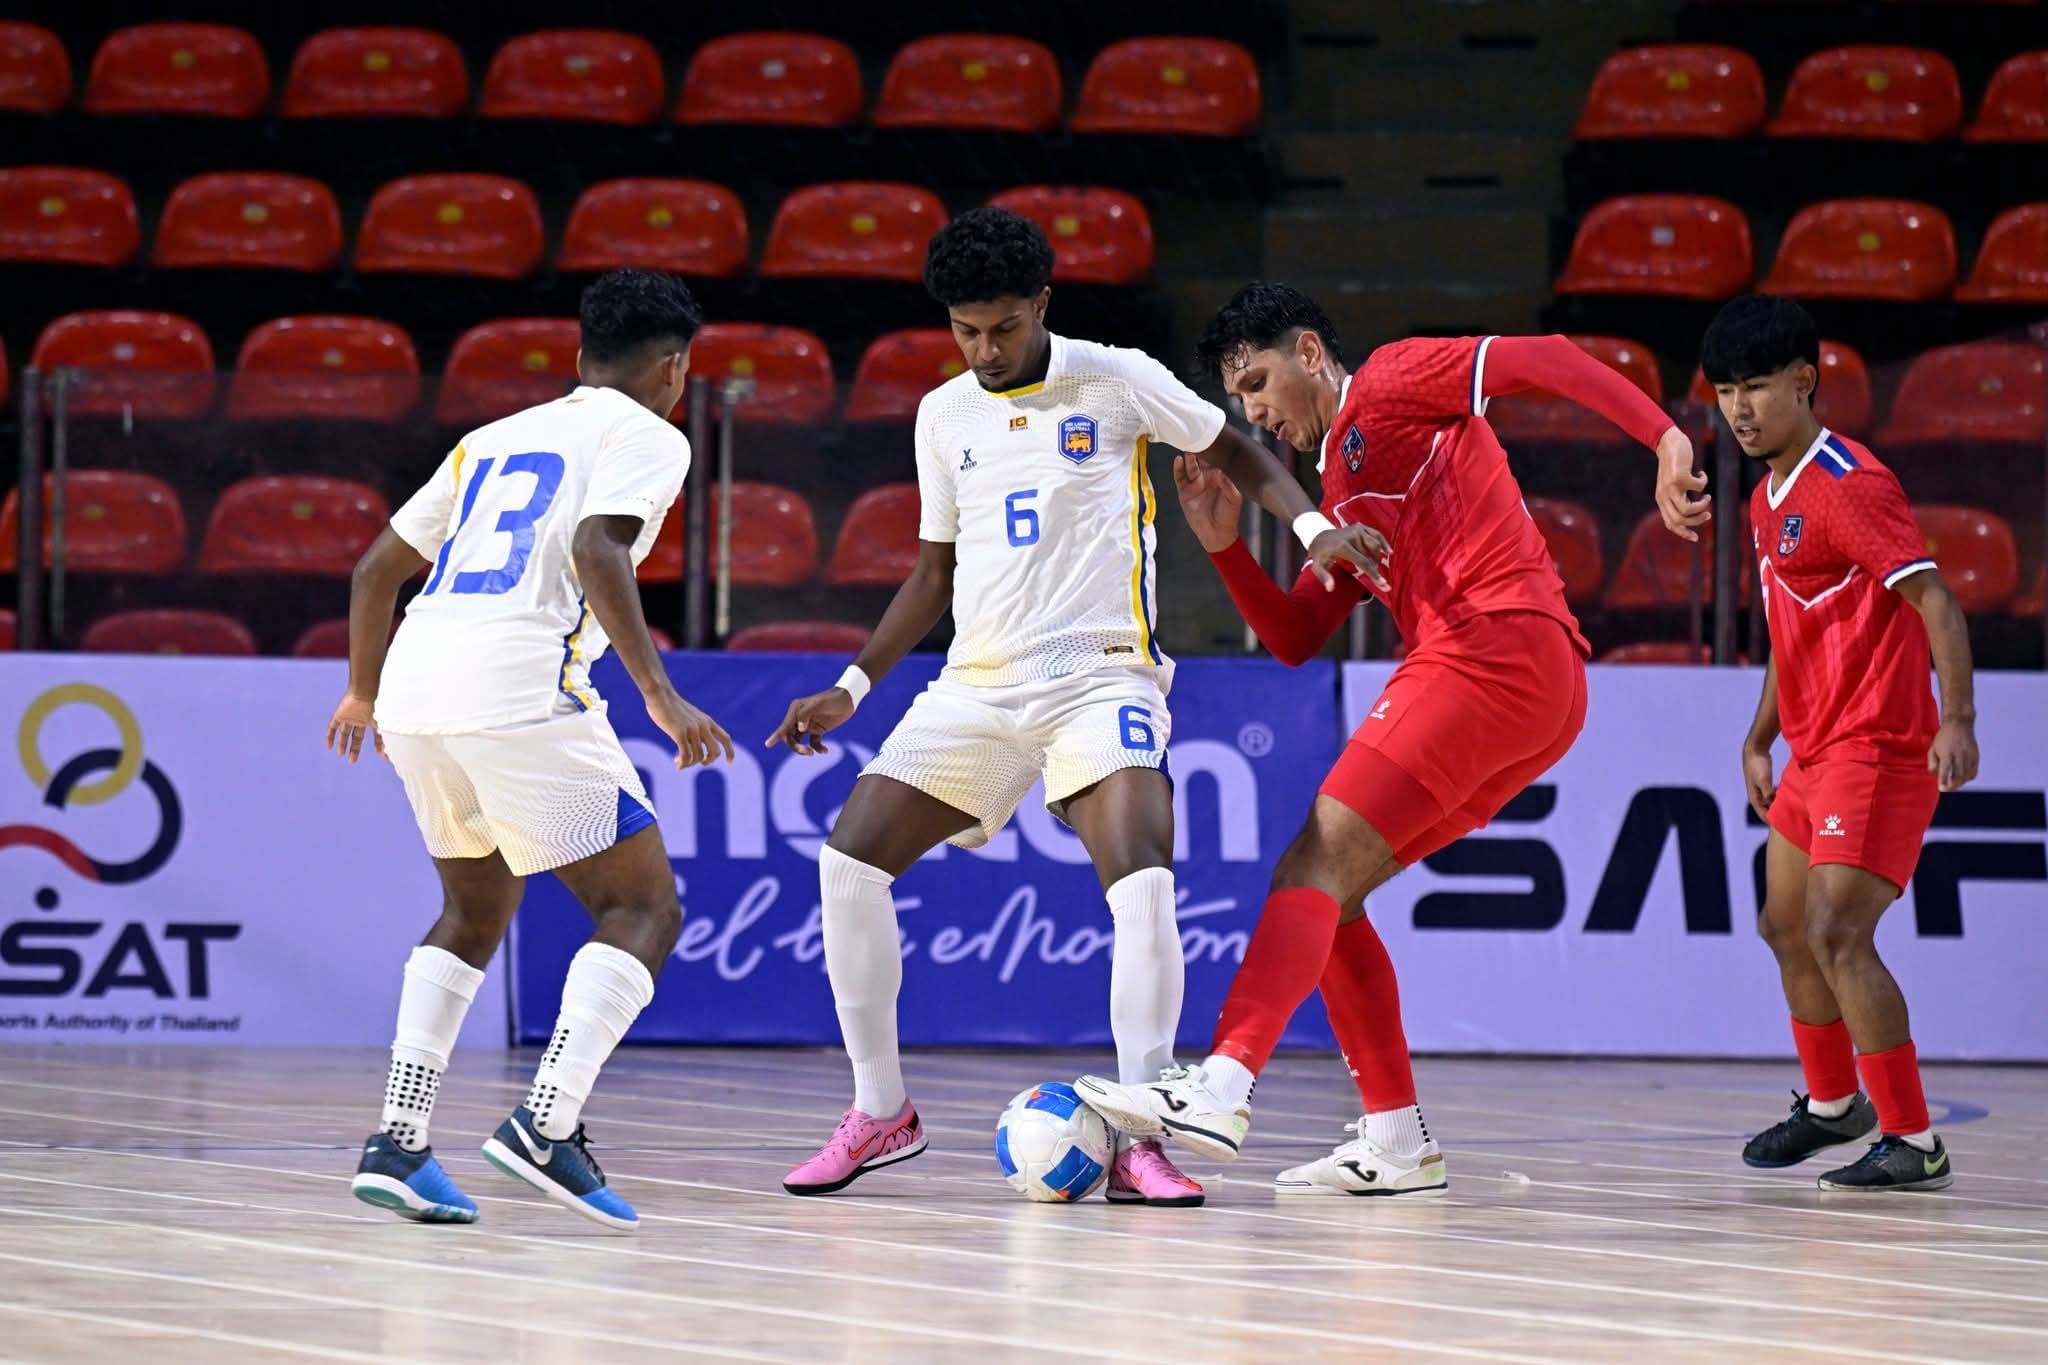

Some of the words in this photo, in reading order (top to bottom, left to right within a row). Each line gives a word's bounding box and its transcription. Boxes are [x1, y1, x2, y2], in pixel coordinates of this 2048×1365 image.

[423, 451, 566, 596] 13
[1004, 488, 1040, 548] 6
[1118, 705, 1155, 752] 6
[1412, 783, 2048, 938] SAF
[0, 920, 242, 999] SAT
[43, 1012, 129, 1034] Authority
[135, 1014, 157, 1031] of
[160, 1014, 242, 1033] Thailand
